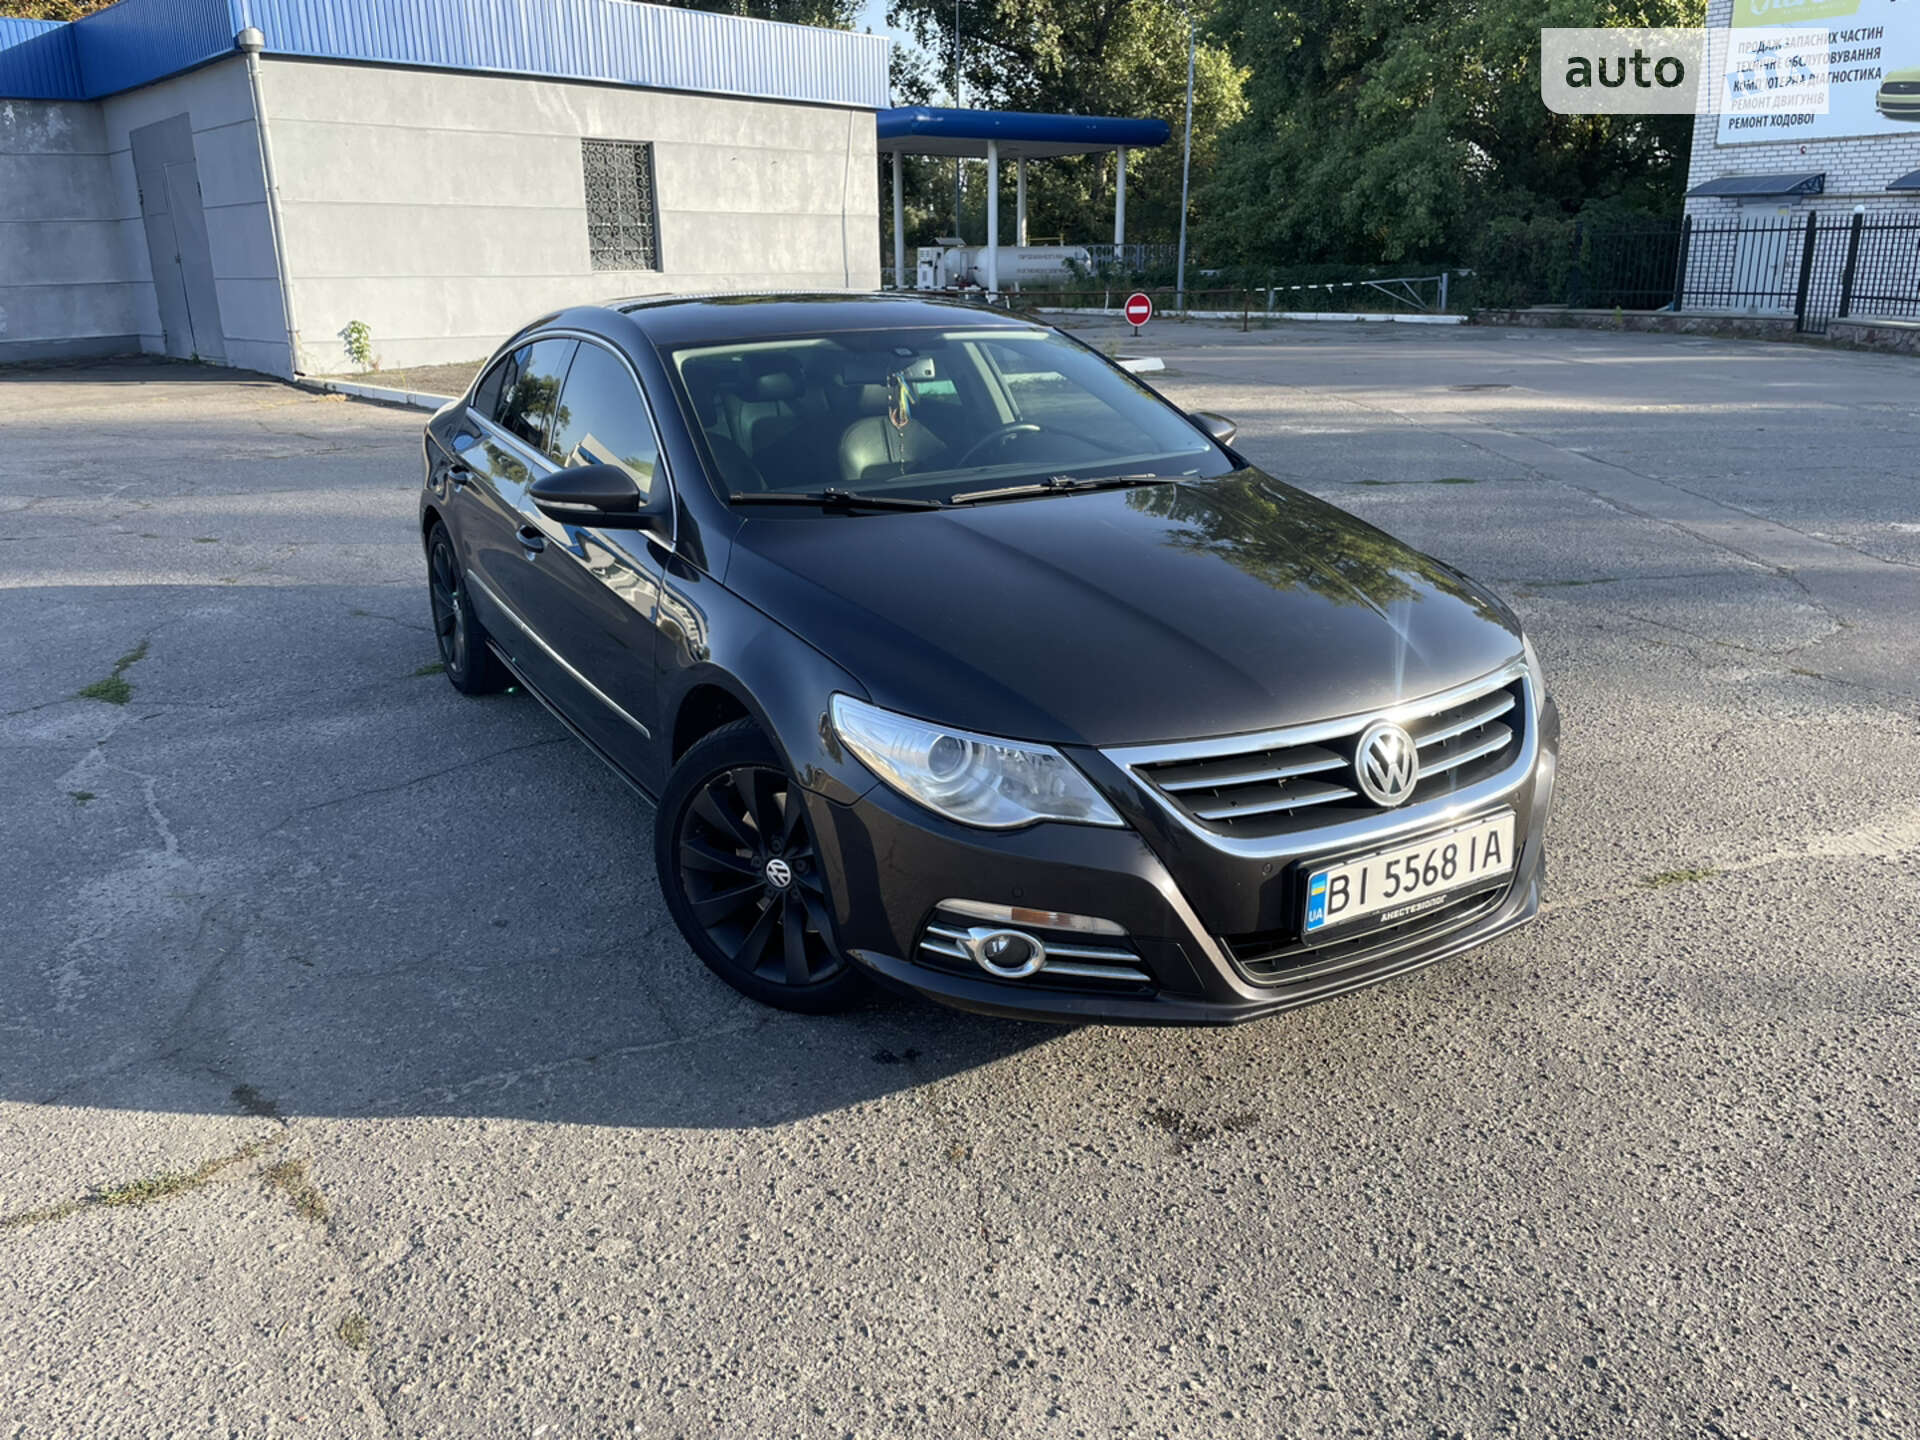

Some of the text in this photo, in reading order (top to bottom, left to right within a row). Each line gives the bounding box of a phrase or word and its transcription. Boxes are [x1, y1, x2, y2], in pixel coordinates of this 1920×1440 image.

[1784, 31, 1838, 48] ЗАПАСНИХ
[1840, 26, 1883, 42] ЧАСТИН
[1784, 47, 1881, 69] ОБСЛУГОВУВАННЯ
[1807, 67, 1882, 88] ДІАГНОСТИКА
[1731, 93, 1825, 111] РЕМОНТ ДВИГУНІВ
[1728, 115, 1769, 130] РЕМОНТ
[1361, 728, 1415, 801] VW
[1327, 830, 1501, 915] BI 5568 IA
[1308, 908, 1323, 922] UA
